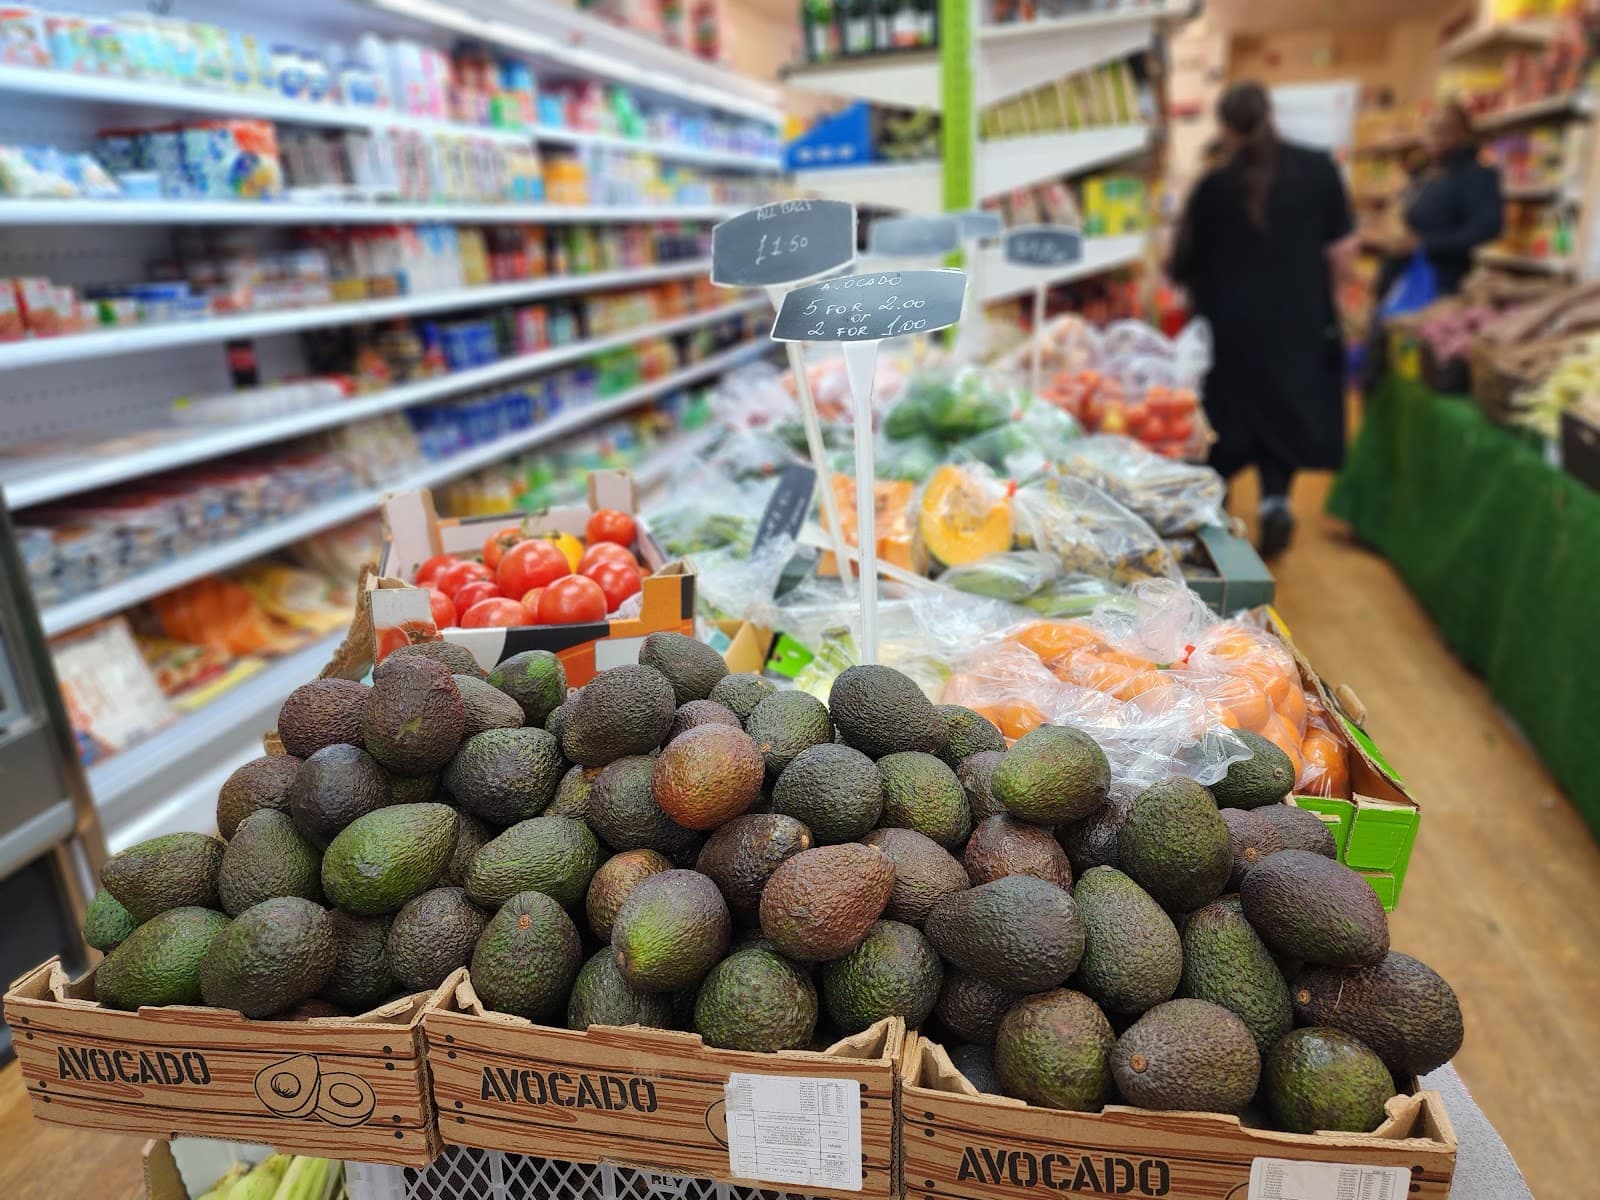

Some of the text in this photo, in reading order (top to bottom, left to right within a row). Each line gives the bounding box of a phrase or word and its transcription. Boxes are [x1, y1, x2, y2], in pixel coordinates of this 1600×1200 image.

[820, 275, 902, 291] AVOCADO
[803, 296, 925, 315] 5 FOR 2.00
[807, 315, 926, 336] 2 FOR 1.00
[57, 1046, 211, 1085] AVOCADO
[481, 1066, 657, 1113] AVOCADO
[957, 1146, 1170, 1196] AVOCADO
